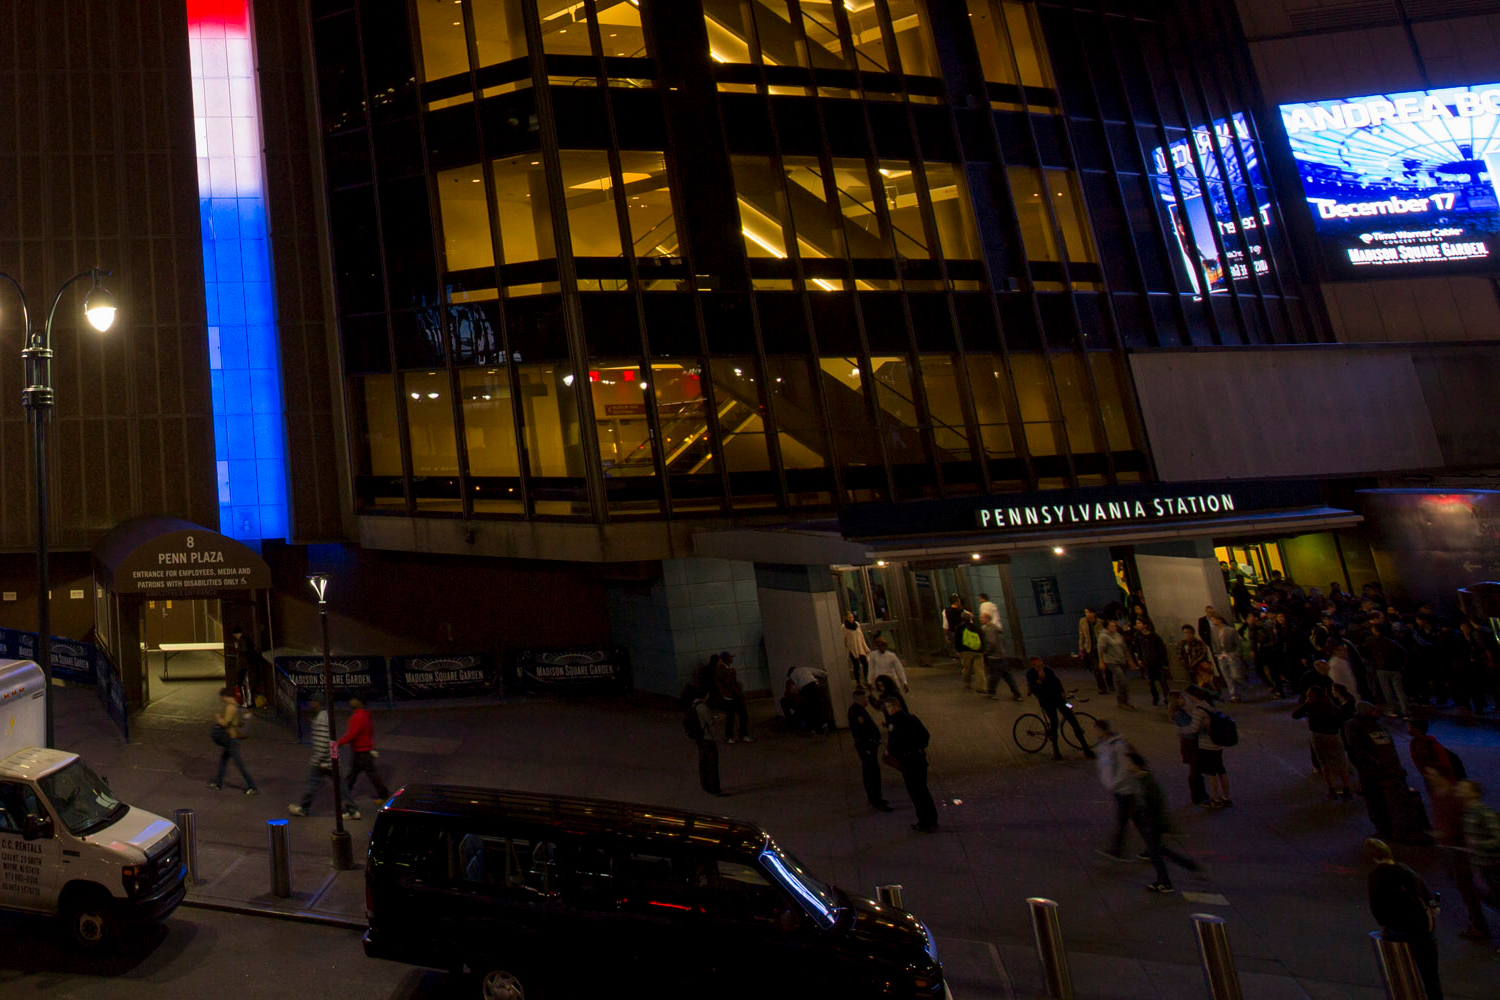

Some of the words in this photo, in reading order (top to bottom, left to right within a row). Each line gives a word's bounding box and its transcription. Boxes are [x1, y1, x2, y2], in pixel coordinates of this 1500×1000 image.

[1289, 94, 1455, 133] ANDREA
[1317, 196, 1429, 218] December
[1429, 193, 1455, 210] 17
[1371, 231, 1396, 240] Time
[1395, 230, 1431, 239] Warner
[1348, 248, 1398, 263] MADISON
[1398, 245, 1441, 260] SQUARE
[980, 501, 1146, 527] PENNSYLVANIA
[1153, 494, 1235, 516] STATION
[186, 536, 195, 549] 8
[158, 552, 188, 565] PENN
[190, 551, 224, 563] PLAZA
[133, 570, 164, 578] ENTRANCE
[165, 569, 177, 577] FOR
[179, 568, 216, 577] EMPLOYEES,
[238, 567, 251, 575] AND
[137, 581, 165, 589] PATRONS
[166, 580, 182, 588] WITH
[183, 578, 223, 587] DISABILITIES
[405, 672, 433, 684] MADISON
[434, 670, 458, 683] SQUARE
[459, 669, 484, 680] GARDEN
[536, 666, 564, 677] MADISON
[565, 664, 588, 676] SQUARE
[589, 664, 615, 675] GARDEN
[345, 672, 372, 685] GARDEN
[15, 841, 42, 854] RENTALS
